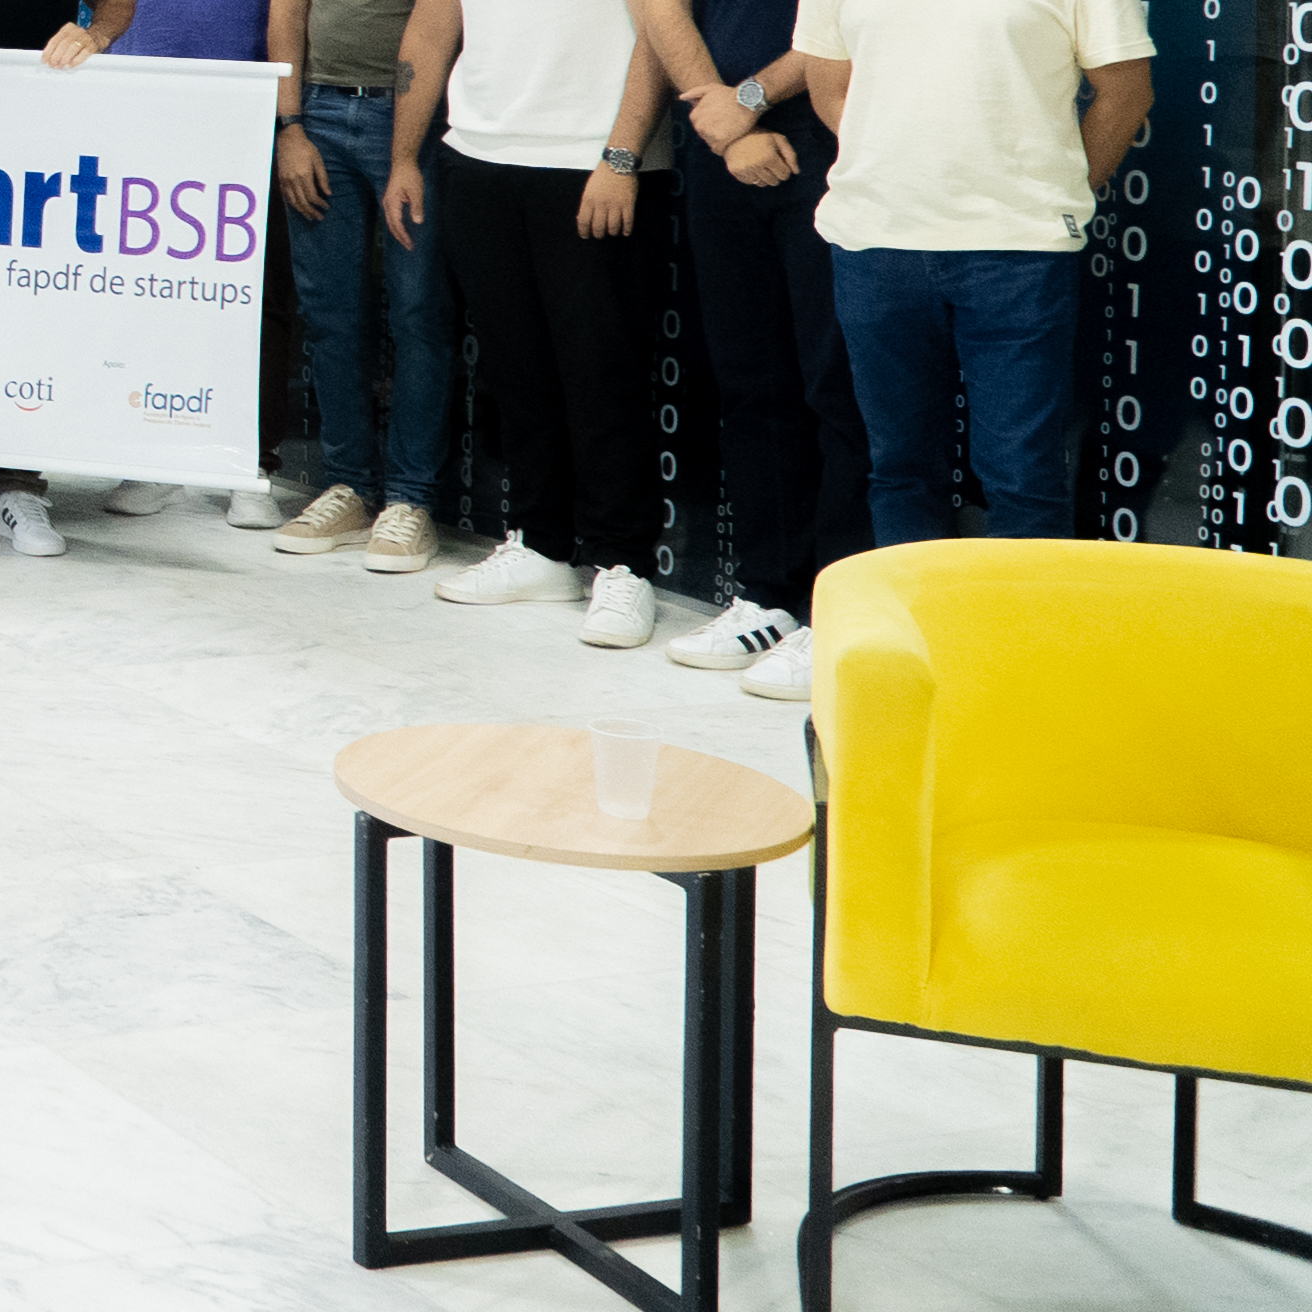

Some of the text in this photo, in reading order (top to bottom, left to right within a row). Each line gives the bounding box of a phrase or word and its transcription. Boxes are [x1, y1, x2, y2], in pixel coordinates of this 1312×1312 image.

[6, 259, 84, 295] fapdf
[89, 266, 126, 295] de
[133, 272, 254, 310] startups
[4, 376, 55, 402] coti
[144, 382, 214, 419] fapdf
